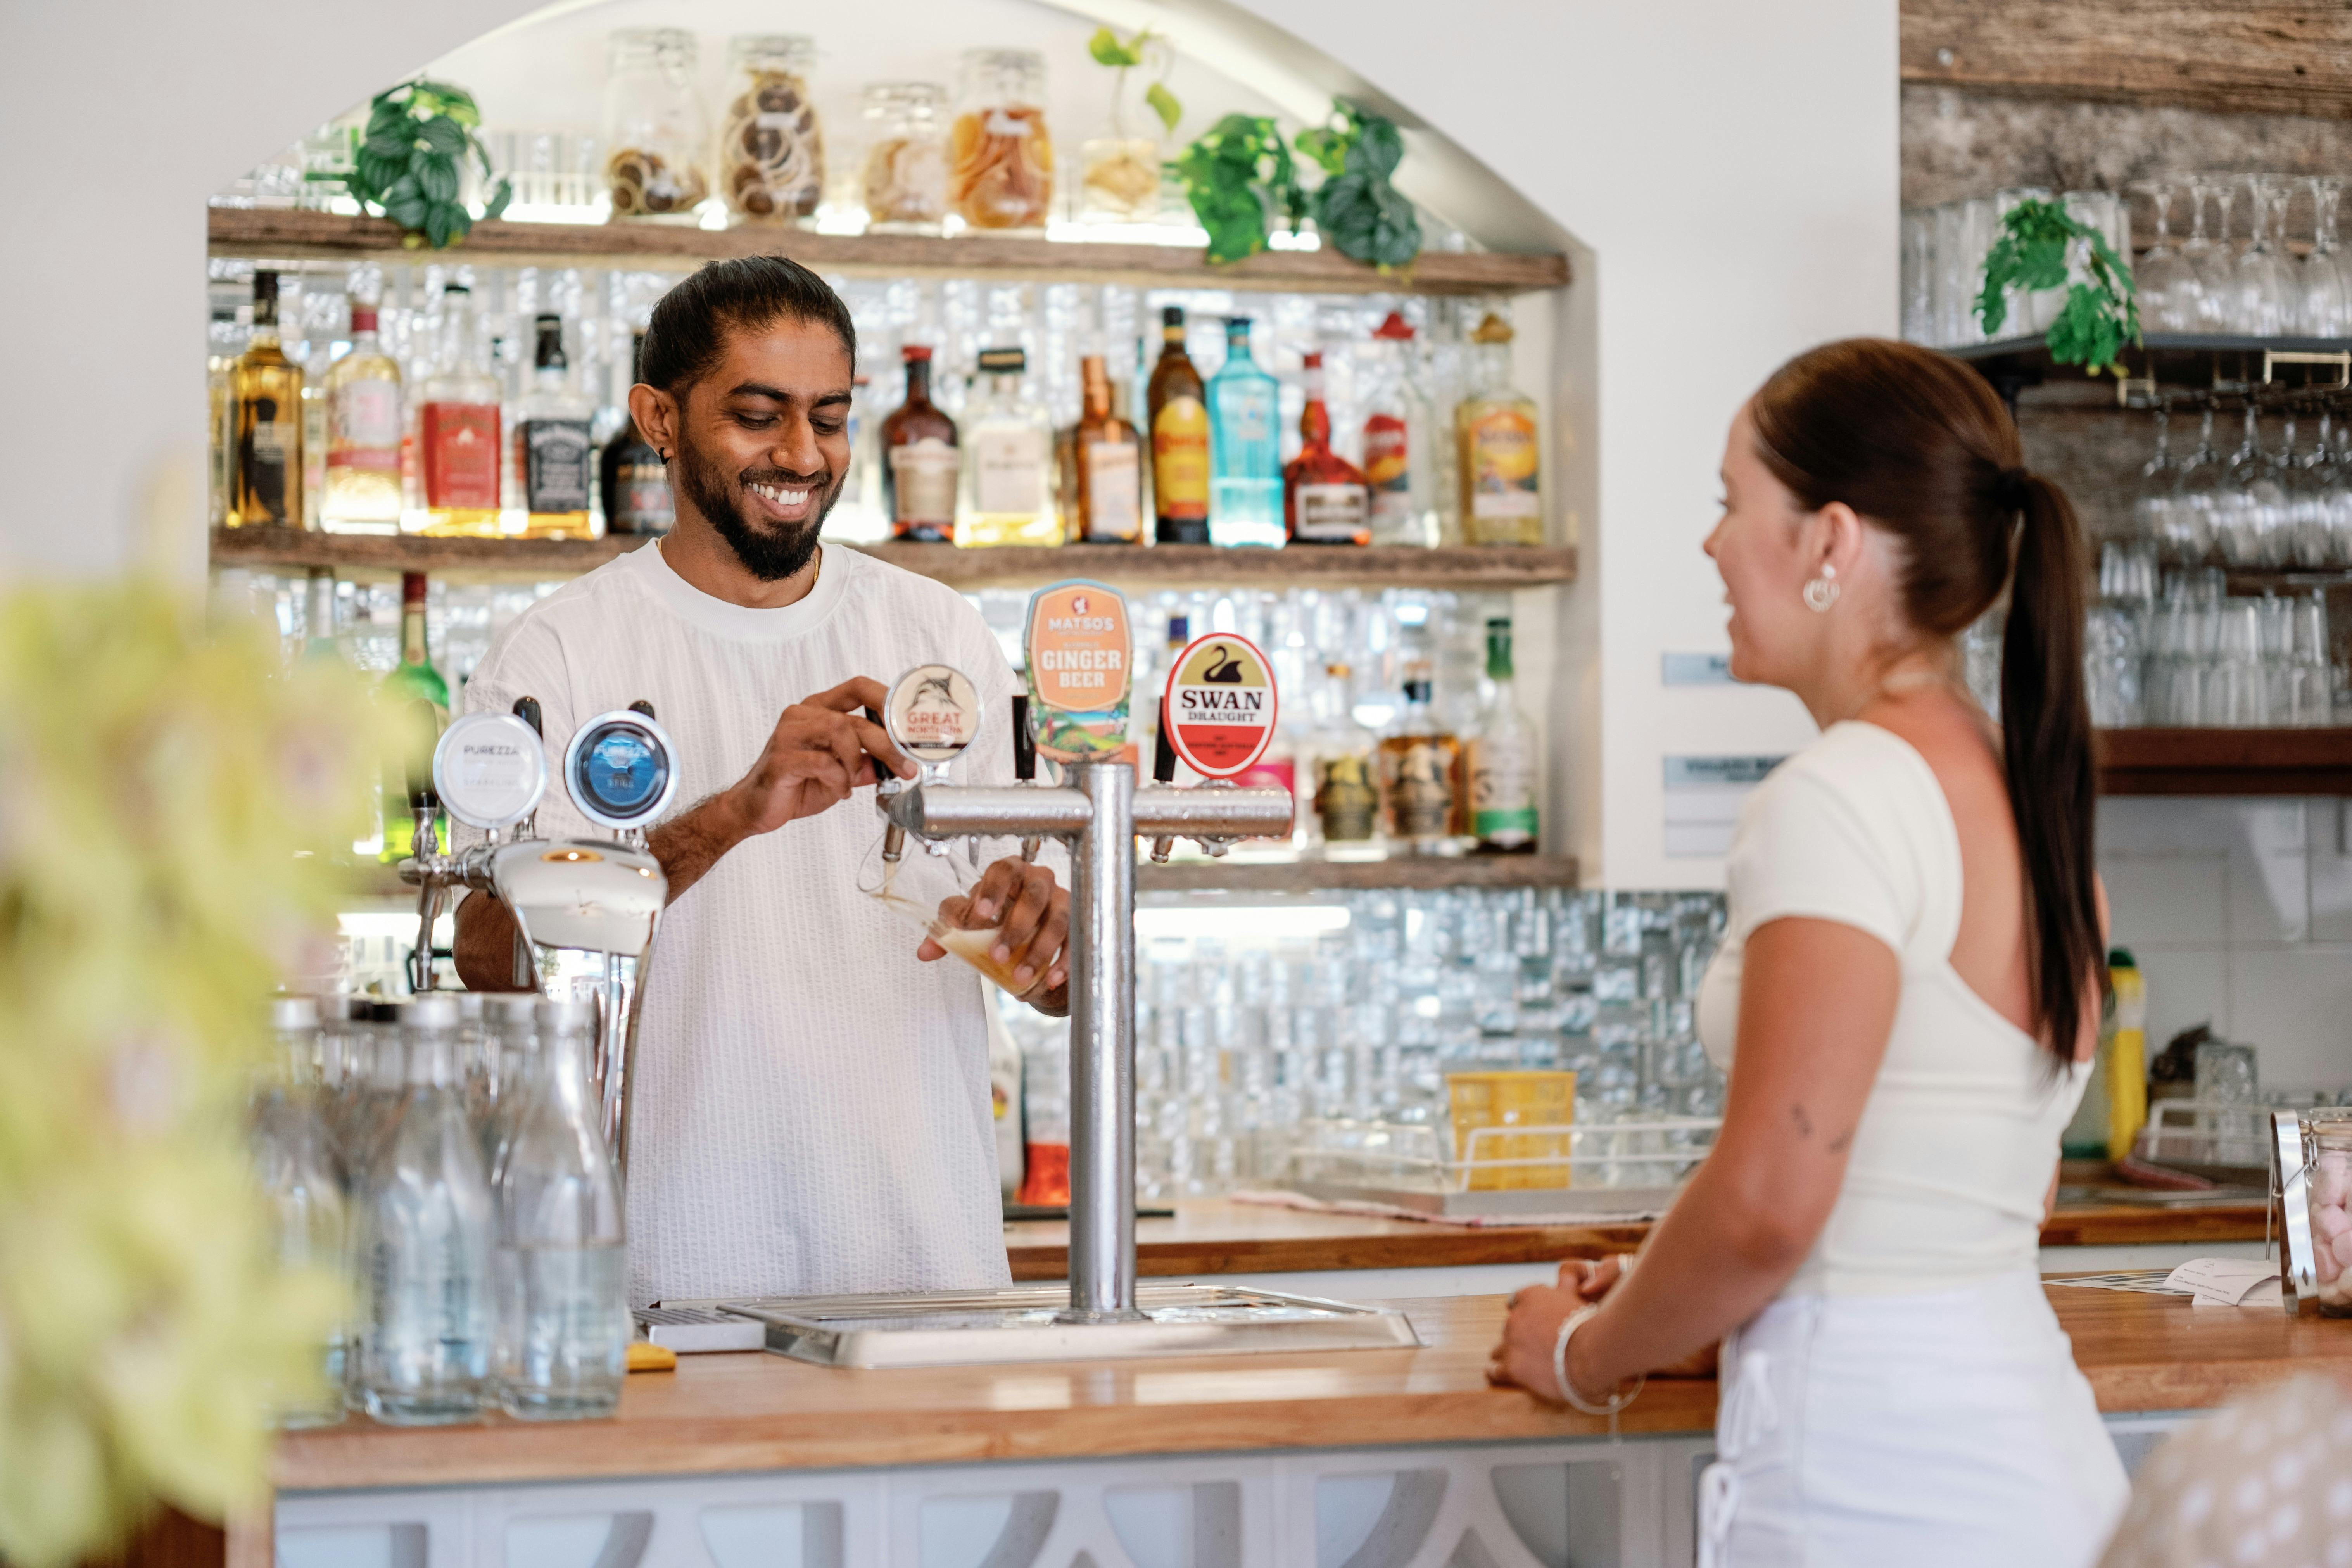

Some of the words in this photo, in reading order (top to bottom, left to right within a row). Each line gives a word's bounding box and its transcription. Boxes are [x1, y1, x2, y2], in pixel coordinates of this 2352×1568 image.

[1048, 617, 1114, 631] MATSO'S
[1041, 649, 1122, 670] GINGER
[1059, 671, 1105, 688] BEER
[1182, 690, 1262, 709] SWAN
[907, 712, 960, 724] GREAT
[1188, 712, 1256, 722] DRAUGHT
[464, 745, 520, 755] PUREZZA
